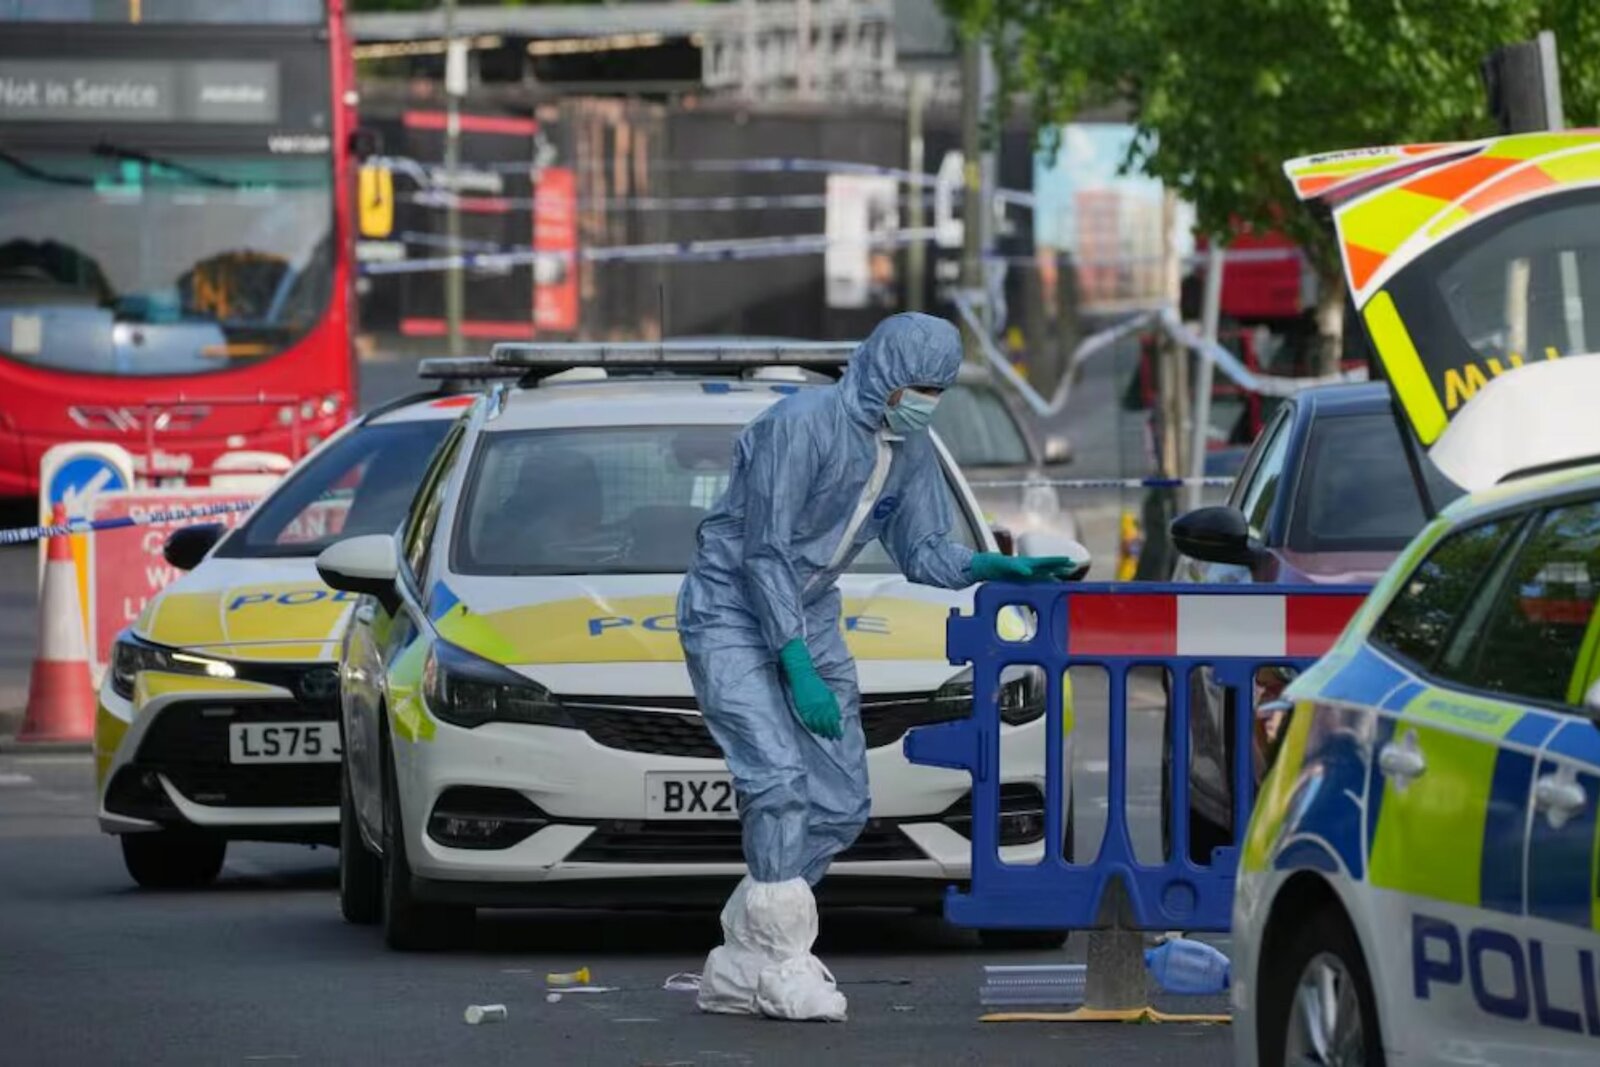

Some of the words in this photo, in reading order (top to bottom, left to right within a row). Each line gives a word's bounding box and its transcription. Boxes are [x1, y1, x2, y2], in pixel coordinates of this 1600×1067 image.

[46, 79, 68, 105] in
[73, 78, 158, 107] Service
[240, 727, 322, 757] LS75
[663, 780, 739, 813] BX2
